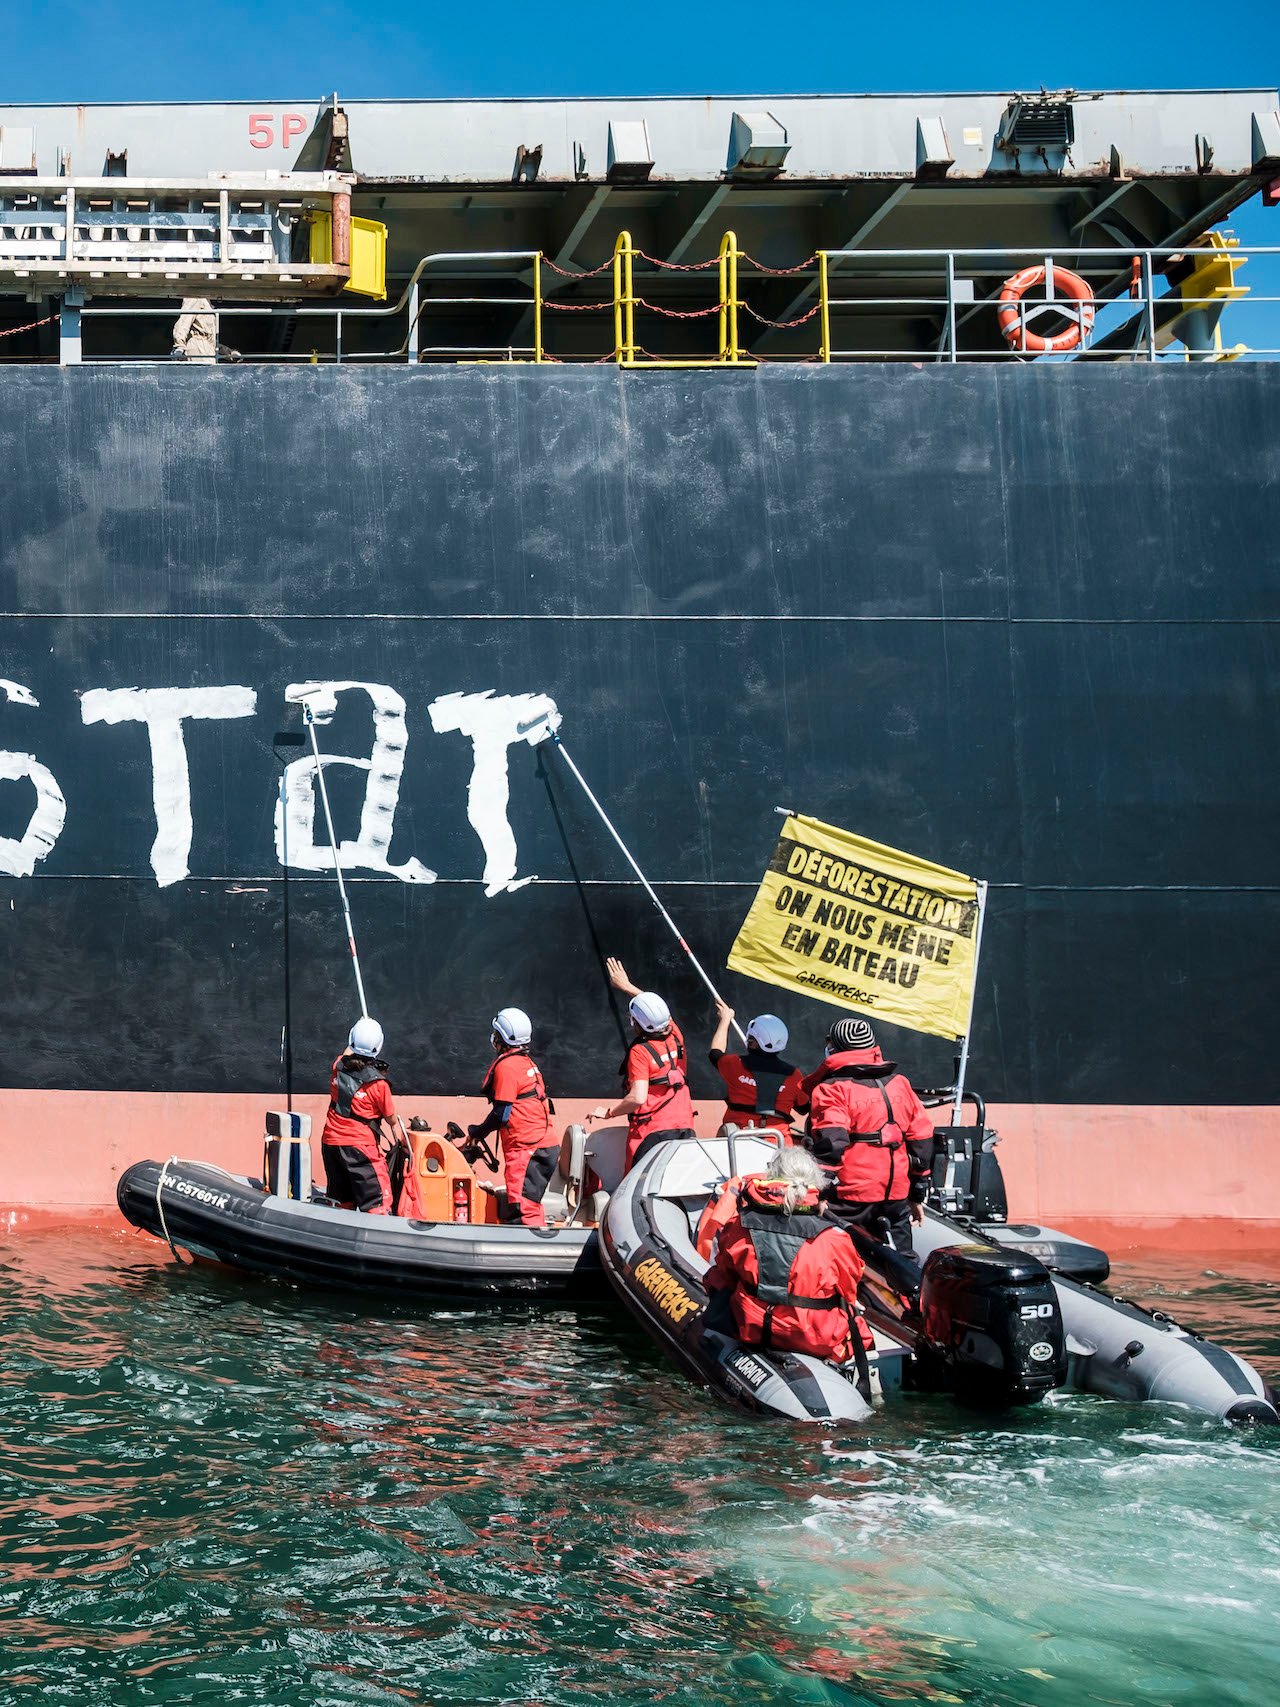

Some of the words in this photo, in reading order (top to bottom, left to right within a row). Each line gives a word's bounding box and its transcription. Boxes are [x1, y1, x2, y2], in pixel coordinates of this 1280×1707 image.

[248, 113, 307, 149] 5P
[786, 846, 962, 929] DÉFORESTATION
[775, 885, 813, 918] ON
[812, 898, 878, 941] NOUS
[780, 922, 821, 957] EN
[819, 936, 920, 989] BATEAU
[795, 970, 880, 1005] GREENPEACE
[176, 1182, 230, 1209] C57601K
[634, 1257, 700, 1323] GREENPEACE
[1020, 1303, 1054, 1320] 50
